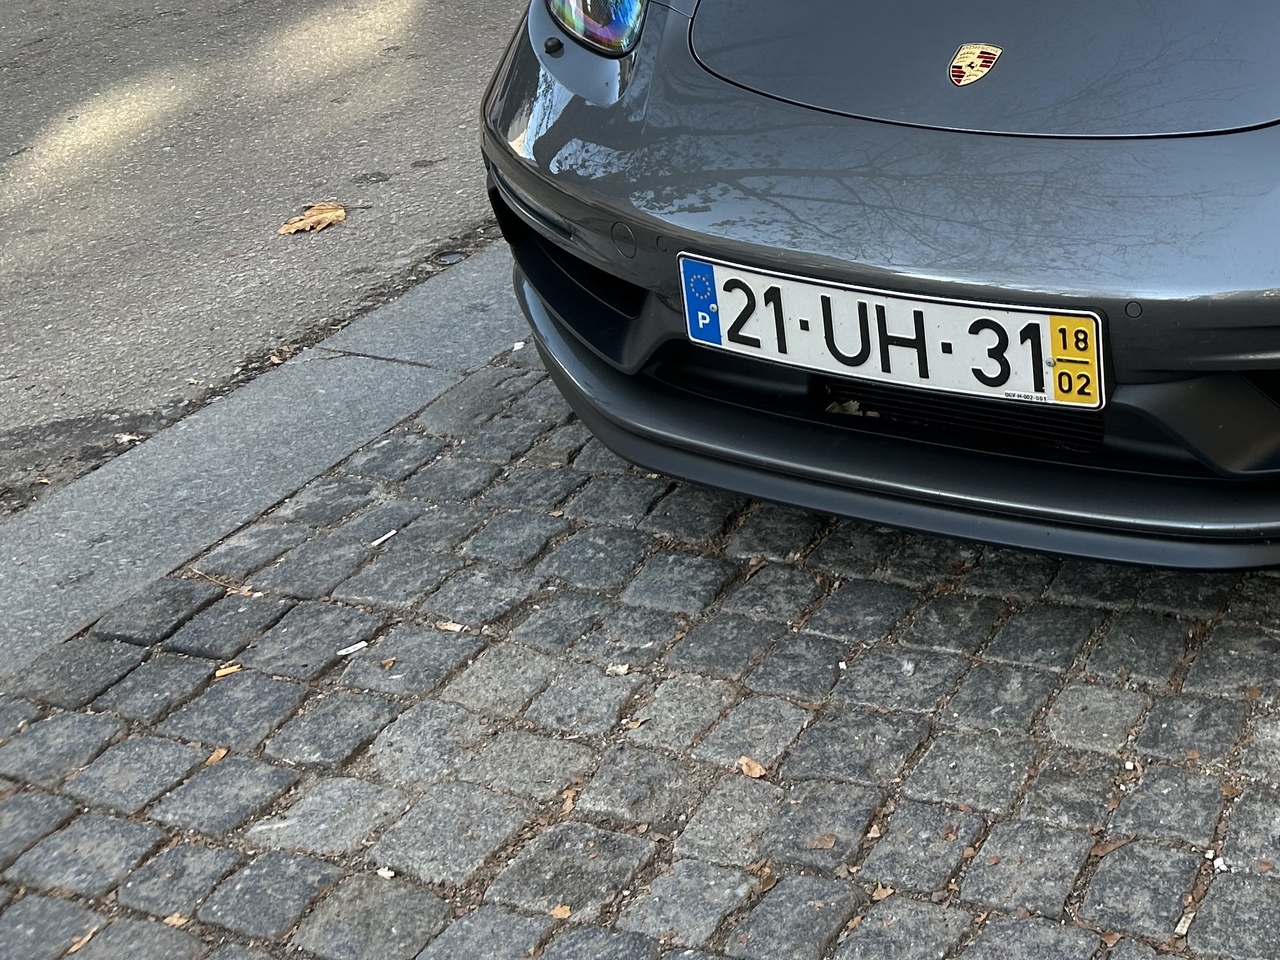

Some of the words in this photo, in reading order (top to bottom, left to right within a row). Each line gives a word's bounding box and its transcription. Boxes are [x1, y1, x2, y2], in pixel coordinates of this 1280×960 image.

[697, 311, 710, 329] P
[1058, 326, 1089, 352] 18
[1058, 371, 1092, 396] 02
